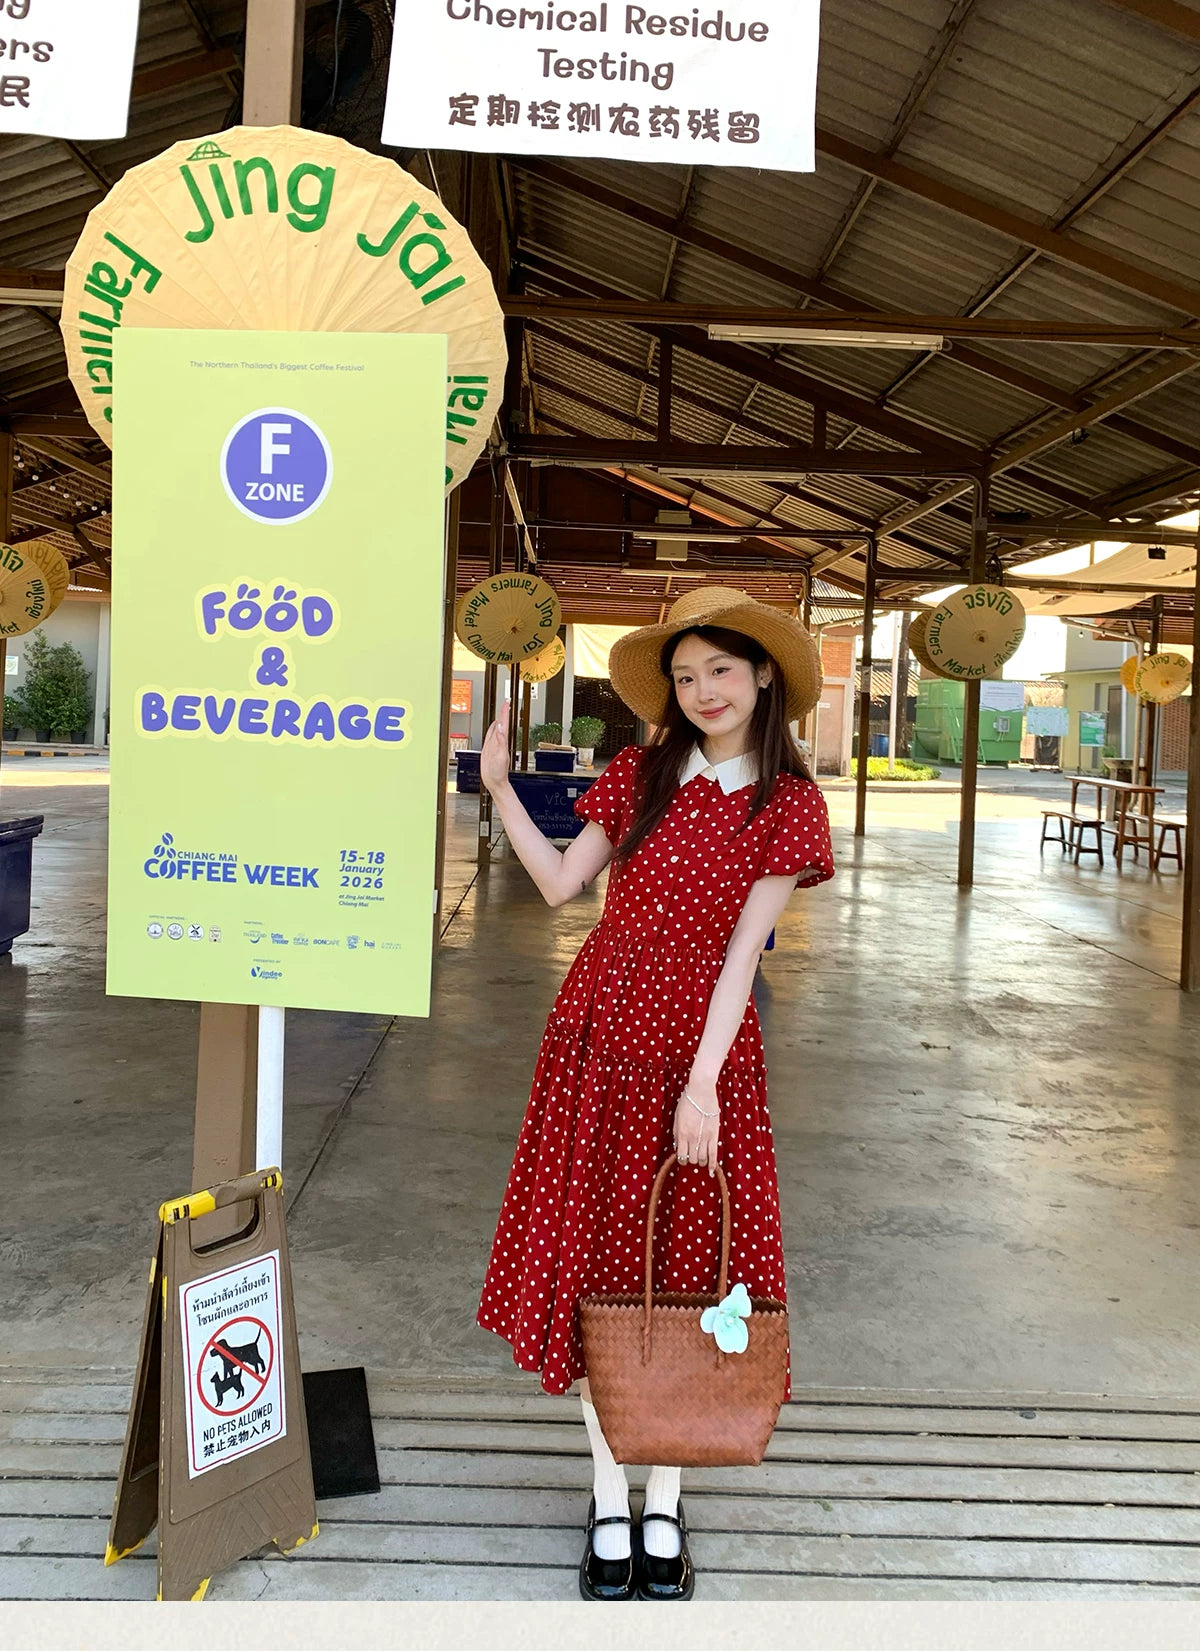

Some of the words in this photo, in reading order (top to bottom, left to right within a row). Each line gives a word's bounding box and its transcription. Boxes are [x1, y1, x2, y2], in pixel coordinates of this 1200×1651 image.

[446, 0, 607, 33] Chemical
[625, 4, 770, 43] Residue
[538, 47, 675, 91] Testing
[448, 92, 761, 144] 定期检测农药残留
[179, 156, 337, 244] Jing
[356, 201, 466, 306] Jai
[205, 361, 239, 369] Northern
[280, 362, 307, 372] Biggest
[310, 363, 334, 371] Coffee
[336, 364, 364, 372] Festival
[260, 422, 292, 474] F
[245, 481, 305, 502] ZONE
[490, 578, 538, 596] Farmers
[464, 591, 490, 628] Market
[534, 597, 554, 628] Jing
[467, 634, 497, 660] Chiang
[497, 652, 513, 661] Mai
[929, 605, 954, 656] Farmers
[943, 658, 987, 676] Market
[256, 646, 288, 687] &
[140, 691, 406, 742] BEVERAGE
[144, 858, 237, 883] COFFEE
[243, 863, 320, 889] WEEK
[177, 851, 216, 861] CHIANG
[218, 853, 238, 862] MAI
[339, 849, 385, 865] 15-18
[339, 863, 384, 877] January
[340, 876, 383, 889] 2026
[203, 1427, 215, 1442] NO
[217, 1419, 237, 1436] PETS
[238, 1402, 273, 1429] ALLOWED
[203, 1419, 271, 1458] 禁止宠物入内
